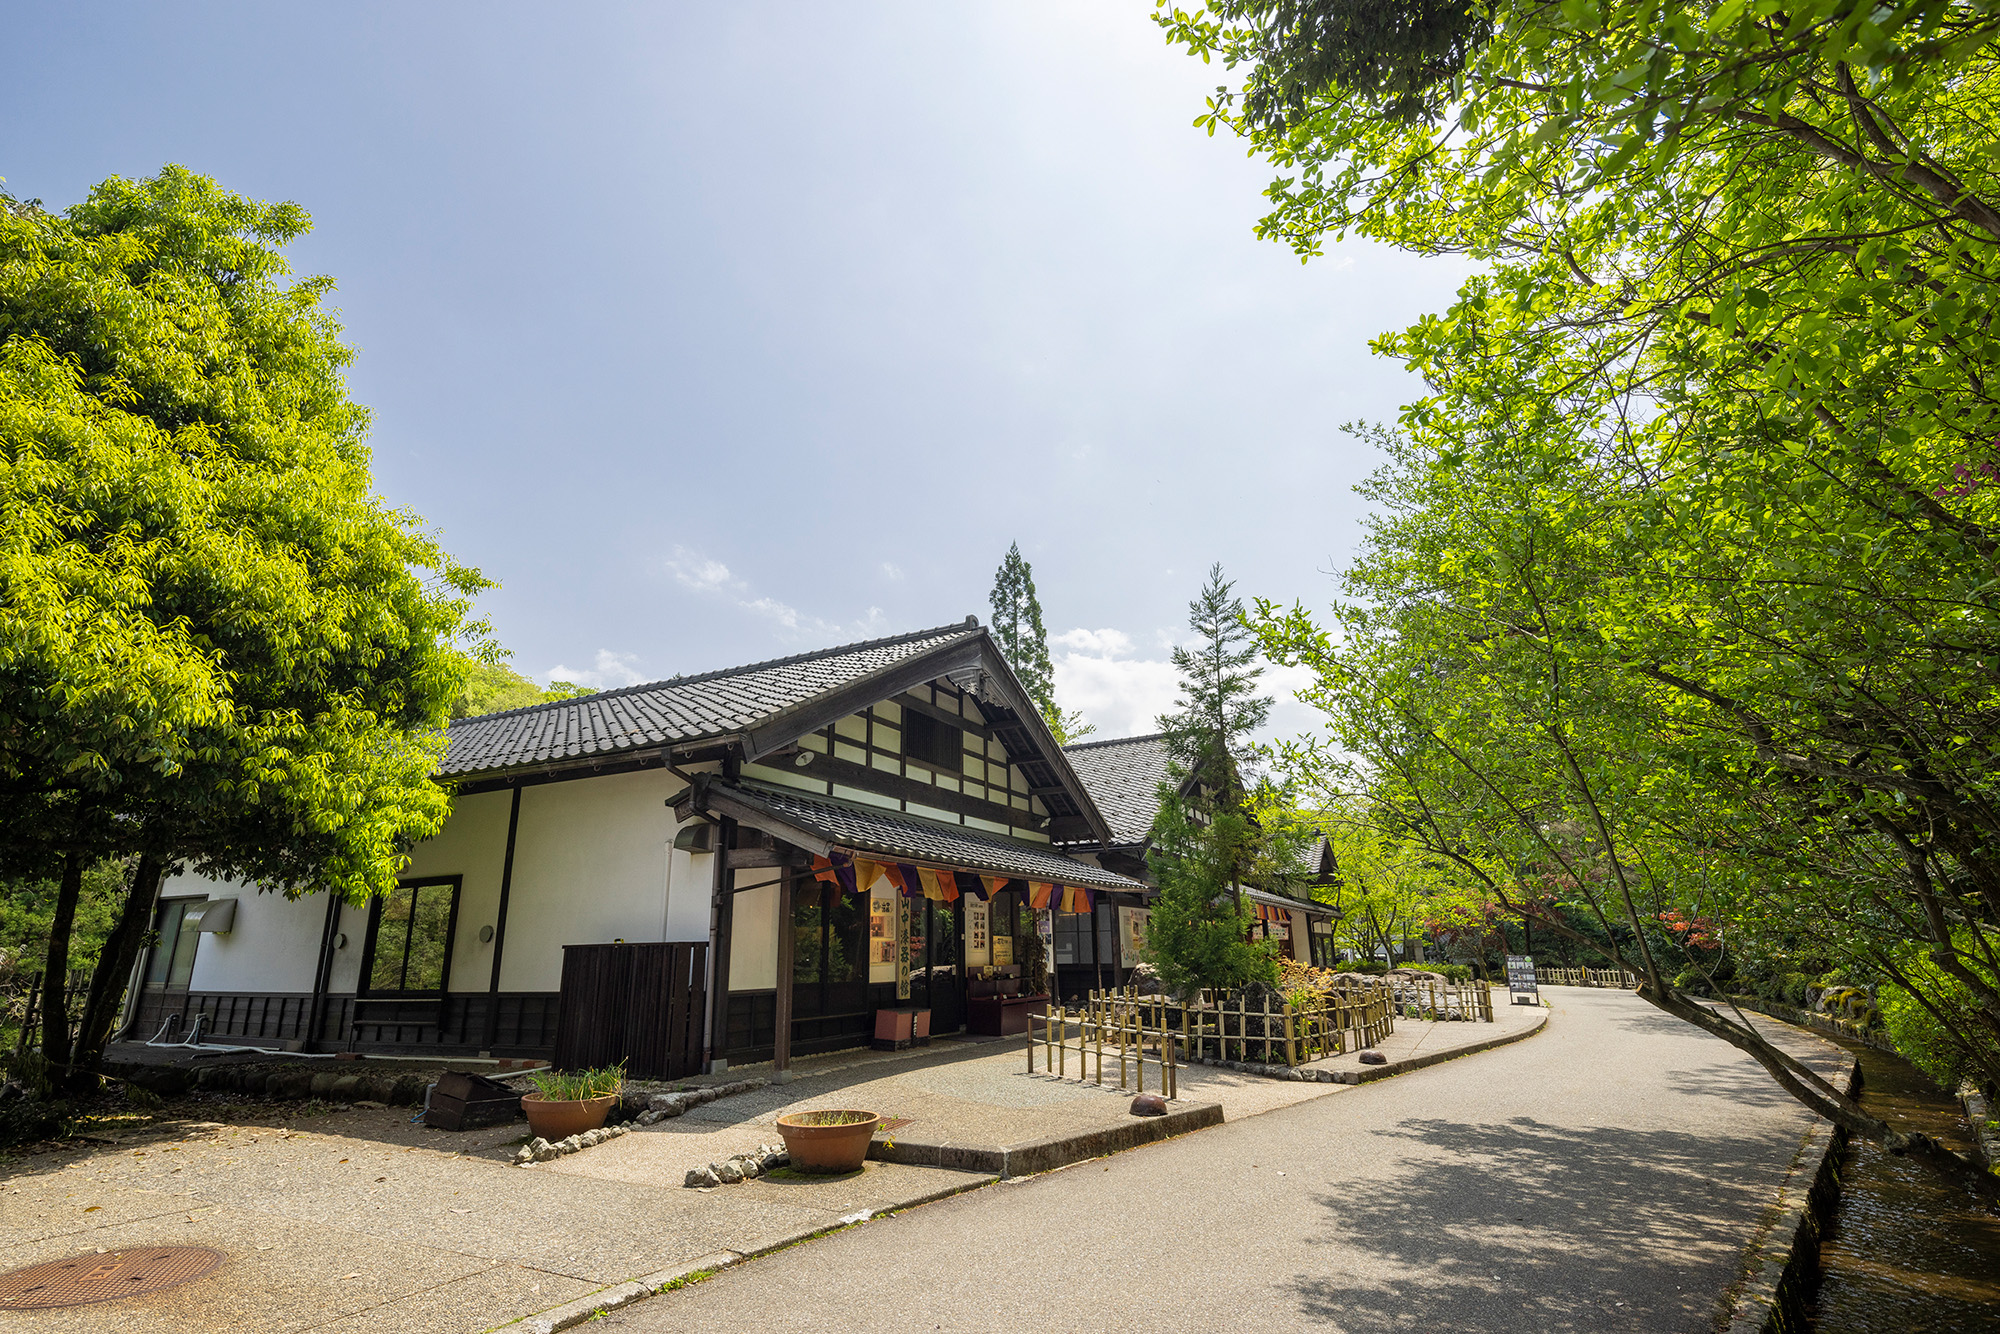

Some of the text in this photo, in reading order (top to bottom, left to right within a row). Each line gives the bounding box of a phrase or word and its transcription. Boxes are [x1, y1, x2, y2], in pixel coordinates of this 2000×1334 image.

[900, 896, 909, 996] 山中漆器の館
